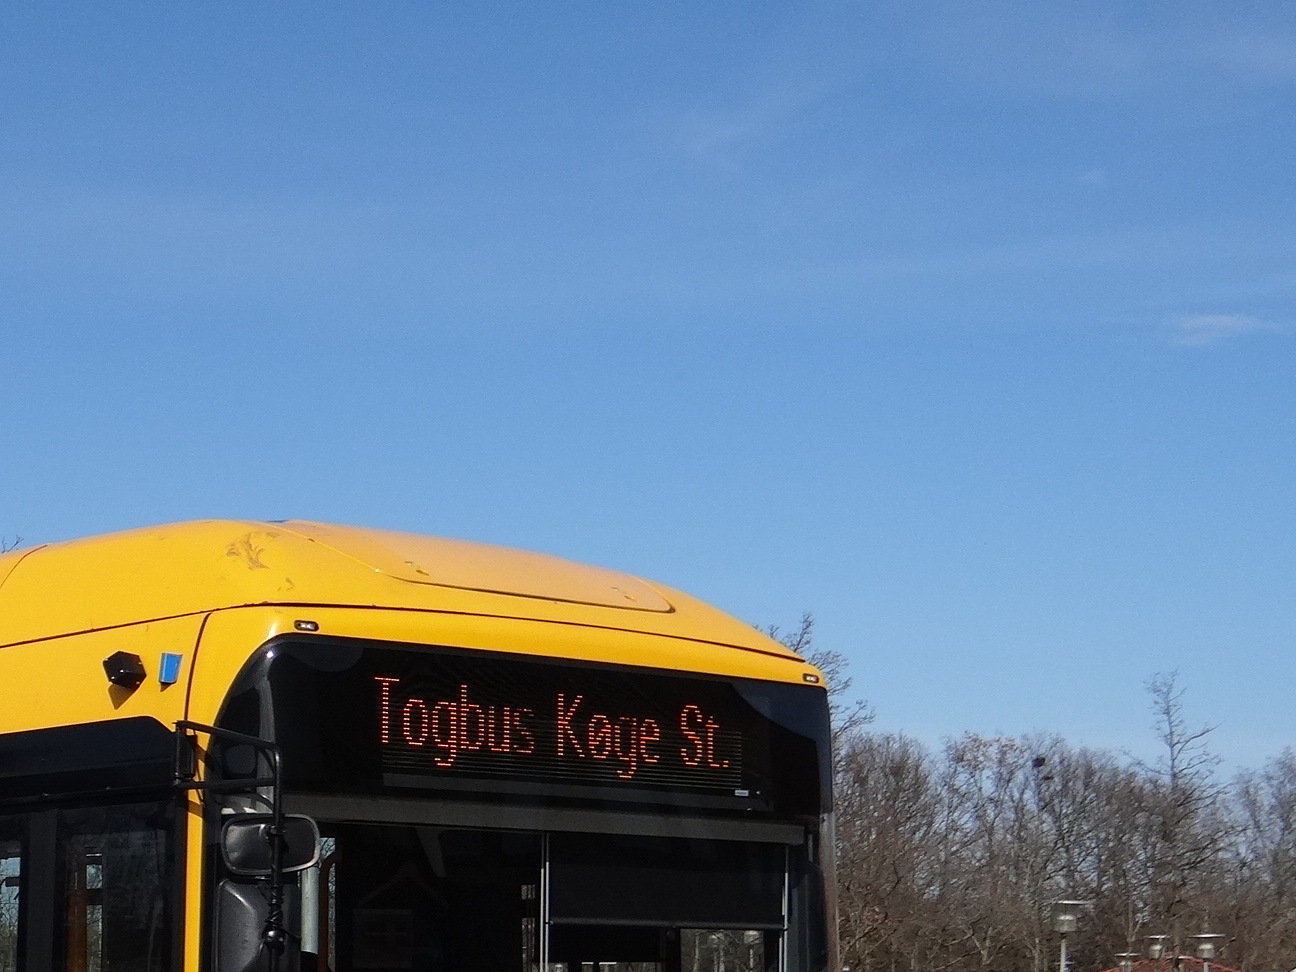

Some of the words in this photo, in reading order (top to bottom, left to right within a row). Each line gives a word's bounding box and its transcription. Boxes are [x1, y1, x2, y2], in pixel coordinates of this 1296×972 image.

[374, 676, 535, 767] Togbus
[557, 692, 661, 779] Køge
[680, 704, 730, 768] St.
